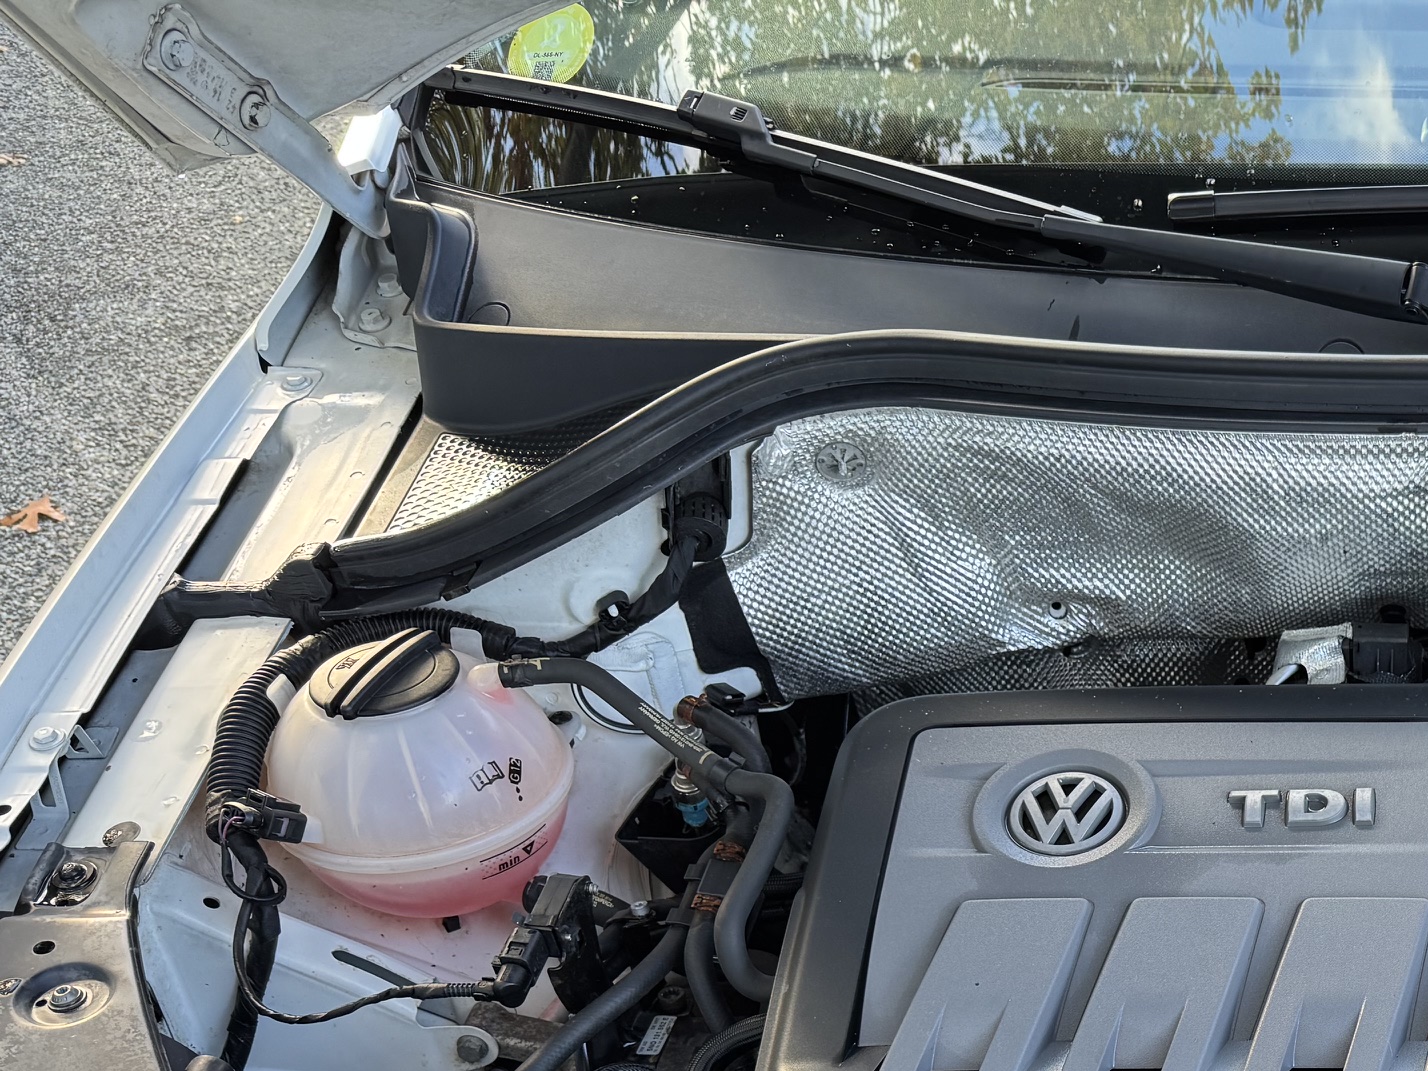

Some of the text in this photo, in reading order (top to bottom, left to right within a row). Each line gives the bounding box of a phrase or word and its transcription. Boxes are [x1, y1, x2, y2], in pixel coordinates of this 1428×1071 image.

[1010, 772, 1124, 855] VW
[1227, 787, 1376, 829] TDI
[499, 855, 520, 871] min
